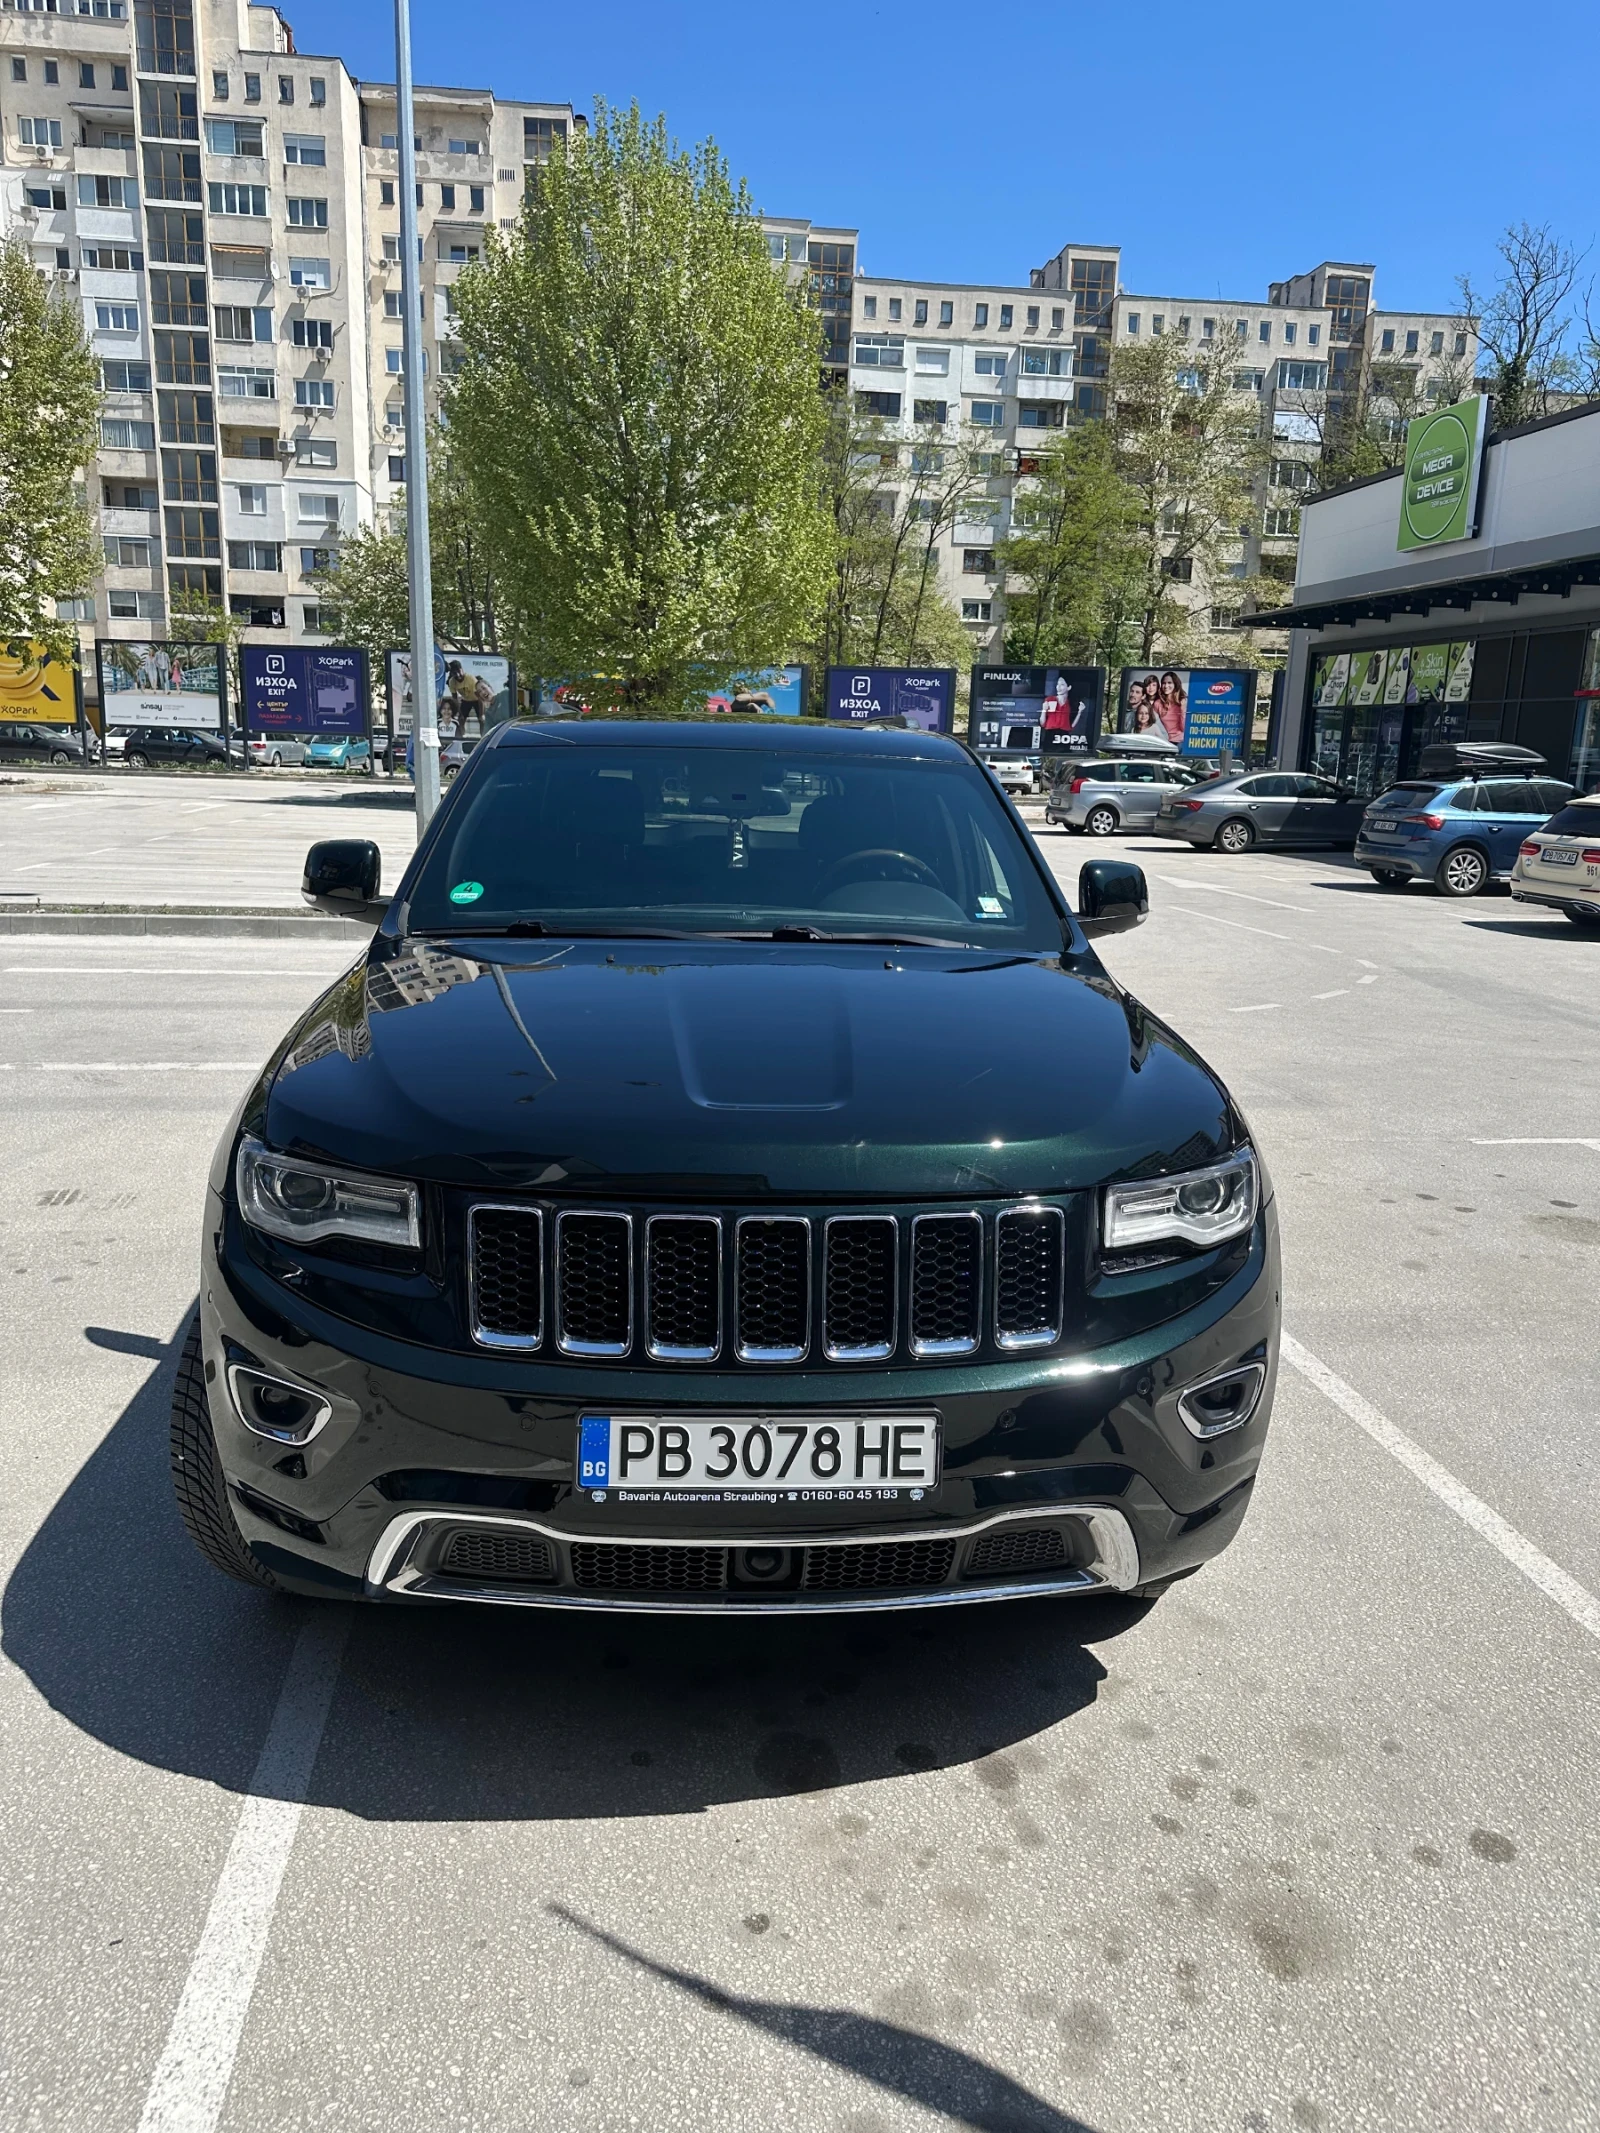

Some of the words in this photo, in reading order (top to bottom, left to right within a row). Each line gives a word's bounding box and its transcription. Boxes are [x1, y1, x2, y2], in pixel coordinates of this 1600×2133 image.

[1422, 454, 1453, 475] MEGA
[1416, 477, 1454, 500] DEVICE
[1426, 652, 1444, 668] Skin
[255, 676, 297, 690] ИЗХОД
[983, 672, 1021, 681] FINLUX
[268, 688, 286, 696] EXIT
[140, 702, 163, 712] sinsay
[840, 698, 881, 711] ИЗХОД
[1191, 713, 1221, 724] ПОВЕЧЕ
[1222, 714, 1245, 726] ИДЕИ
[1189, 726, 1223, 736] ПО-ГОЛЯМ
[1052, 735, 1088, 745] ЗОРА
[1188, 737, 1218, 749] НИСКИ
[1219, 738, 1242, 750] ЦЕНИ
[1586, 865, 1598, 877] 961
[463, 882, 473, 893] 4
[619, 1425, 692, 1479] PB
[704, 1425, 842, 1478] 3078
[854, 1425, 926, 1478] HE
[582, 1461, 607, 1478] BG
[618, 1491, 660, 1501] Bavaria
[663, 1491, 721, 1501] Autoarena
[723, 1491, 777, 1503] Straubing
[856, 1490, 872, 1500] 45
[875, 1489, 898, 1500] 193
